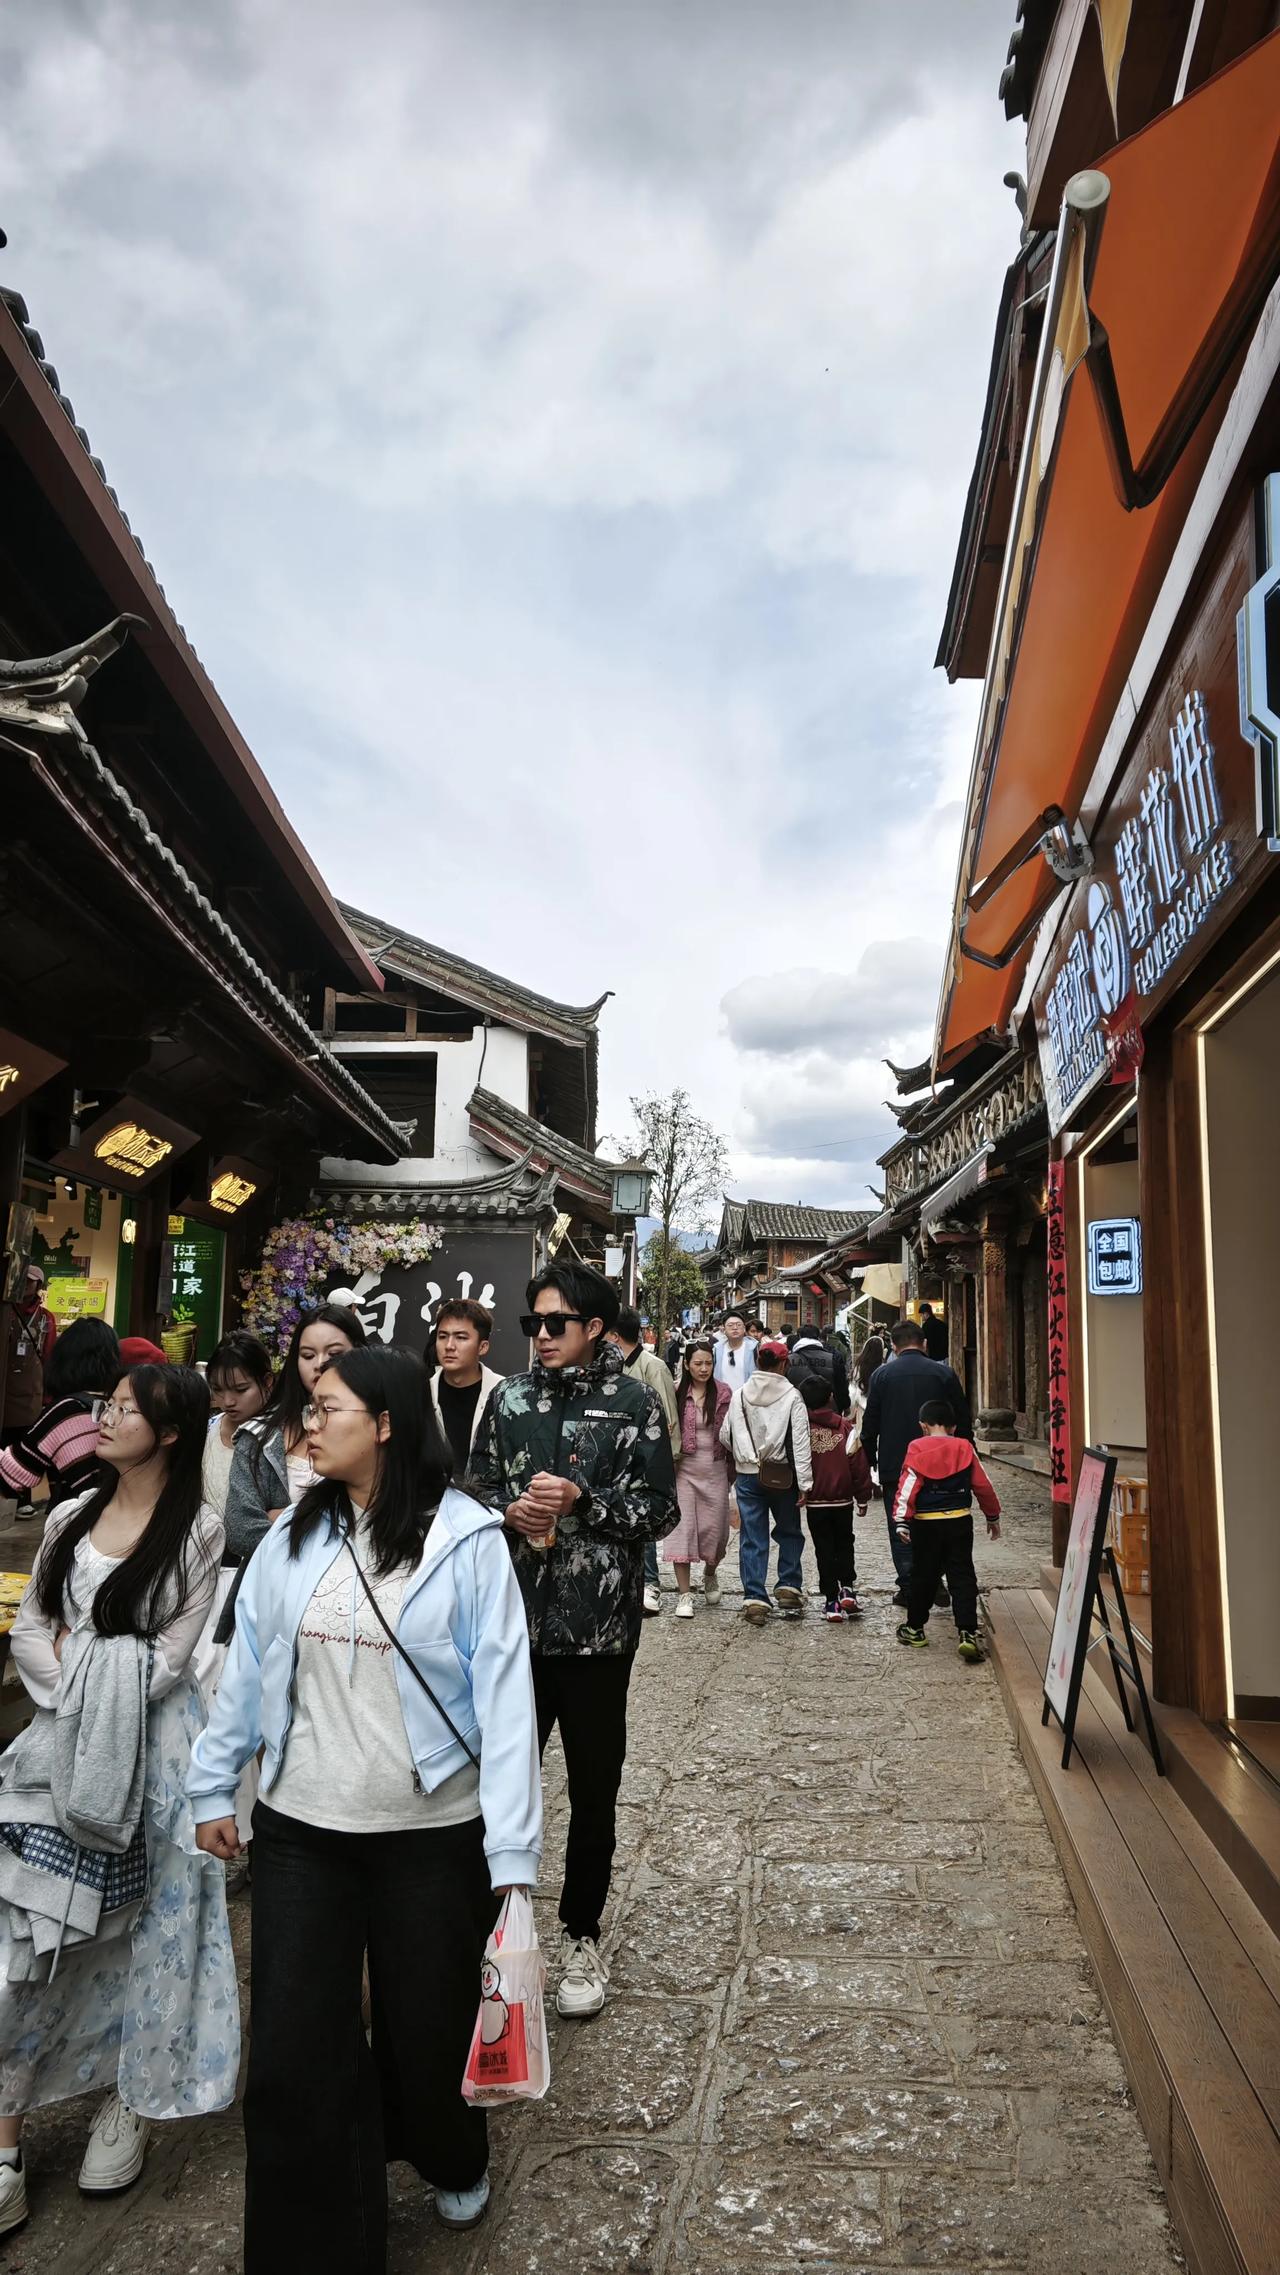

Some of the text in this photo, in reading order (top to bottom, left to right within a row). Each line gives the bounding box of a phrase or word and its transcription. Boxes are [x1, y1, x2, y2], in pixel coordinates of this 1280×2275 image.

[1114, 689, 1219, 949] 鲜花饼
[1098, 1231, 1129, 1253] 全国
[173, 1260, 196, 1273] 道
[1099, 1260, 1131, 1281] 包邮
[172, 1277, 203, 1295] 家
